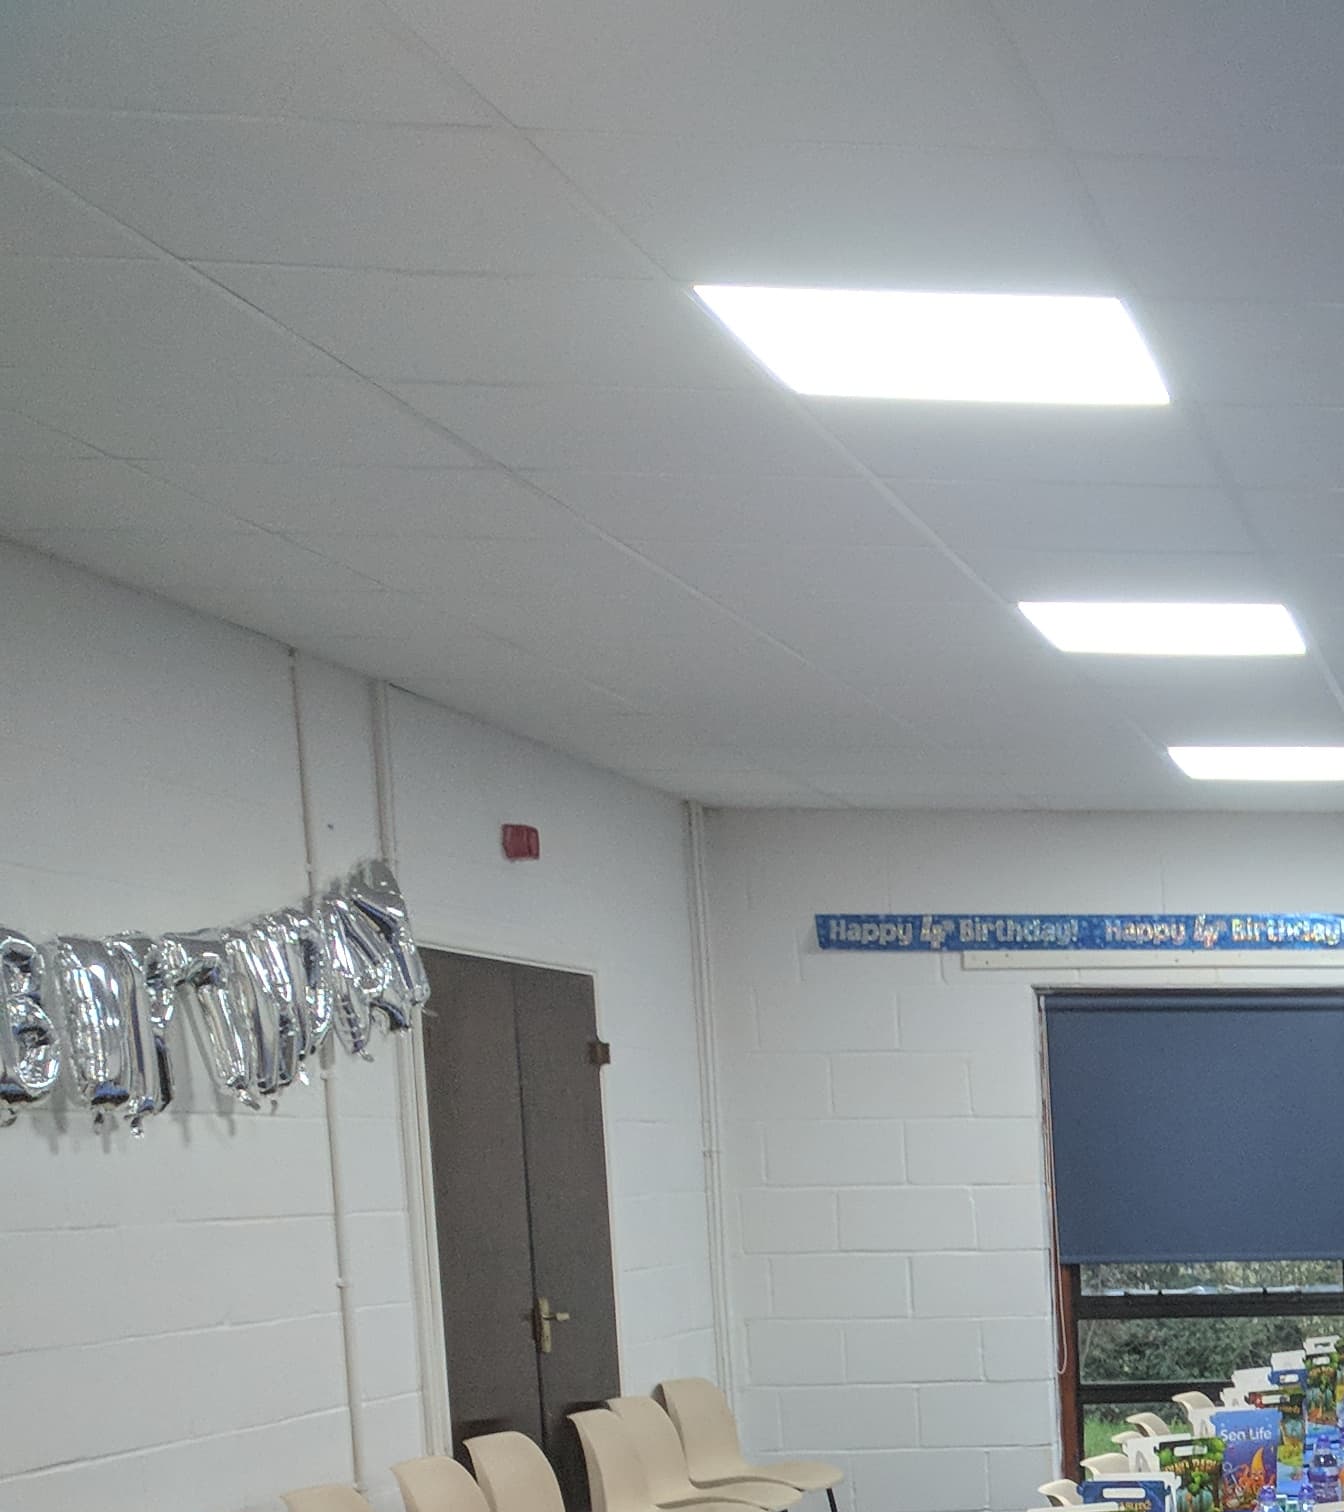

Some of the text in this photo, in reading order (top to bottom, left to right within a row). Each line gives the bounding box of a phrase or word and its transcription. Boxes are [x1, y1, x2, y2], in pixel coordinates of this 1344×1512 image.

[829, 919, 912, 946] Happy
[959, 917, 1078, 945] Birthday!
[1105, 919, 1186, 945] Happy
[1220, 1426, 1273, 1442] Sea Life
